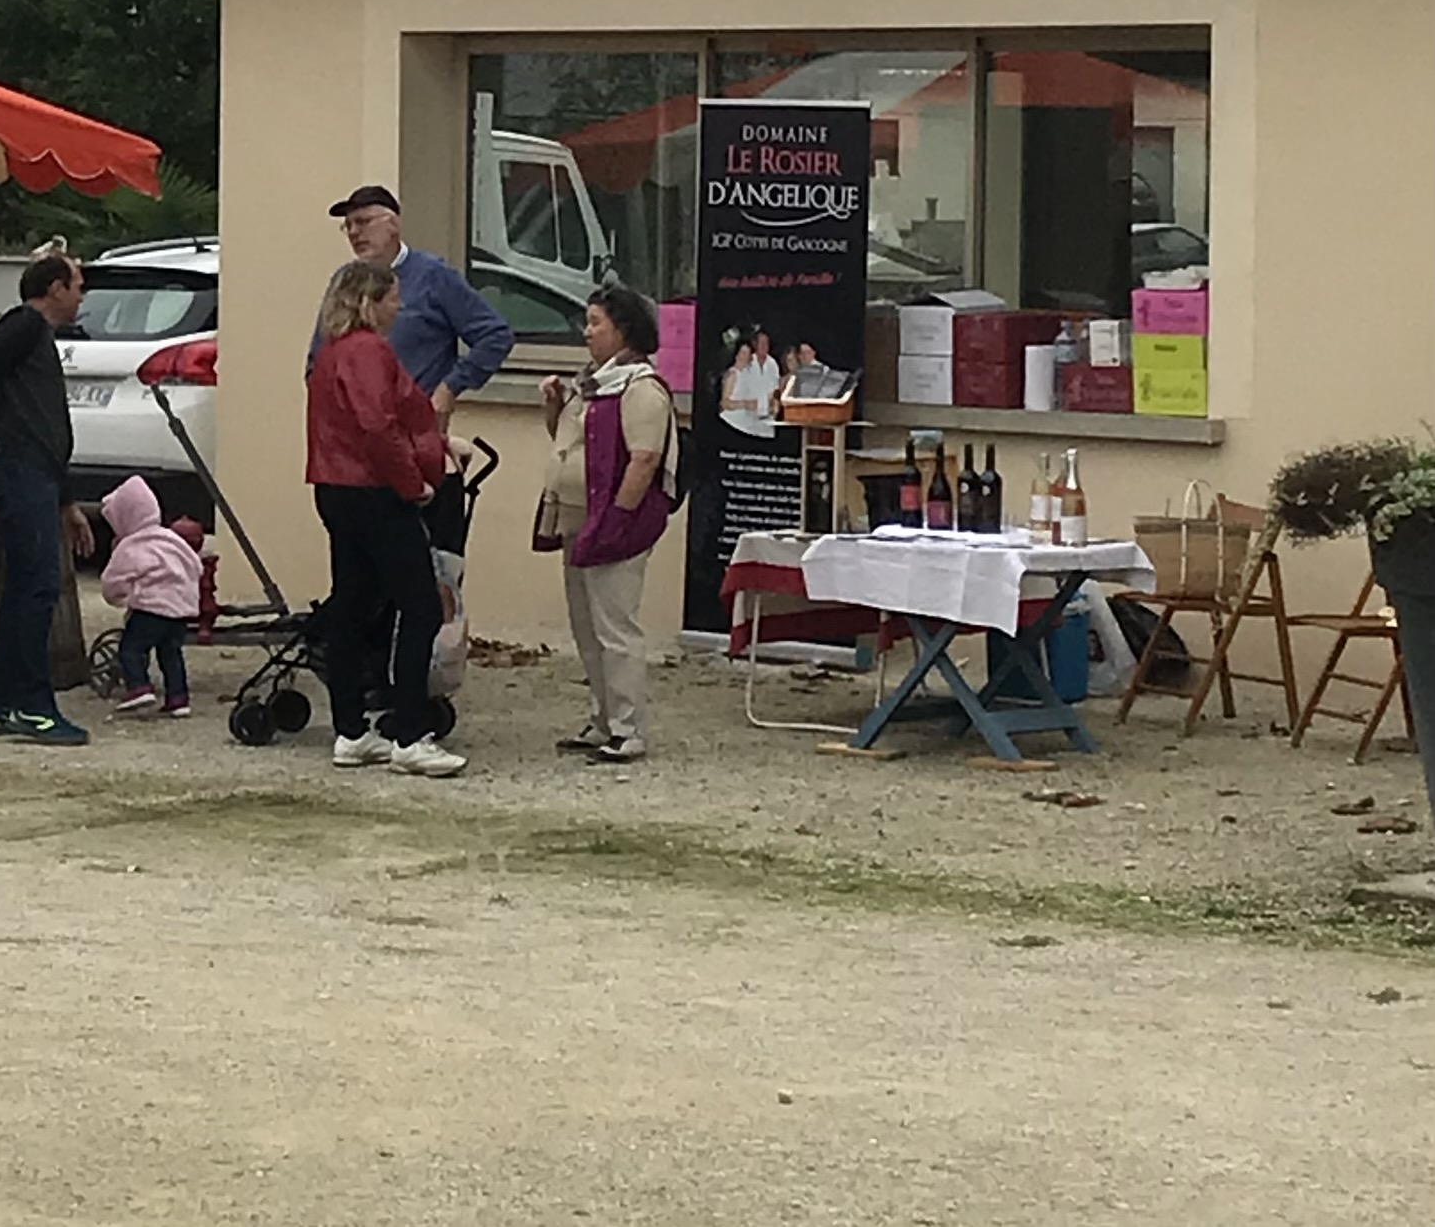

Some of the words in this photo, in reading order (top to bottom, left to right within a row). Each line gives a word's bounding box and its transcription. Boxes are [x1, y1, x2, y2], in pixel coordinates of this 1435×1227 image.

[742, 124, 828, 143] DOMAINE
[727, 144, 752, 174] LE
[760, 145, 842, 176] ROSIER
